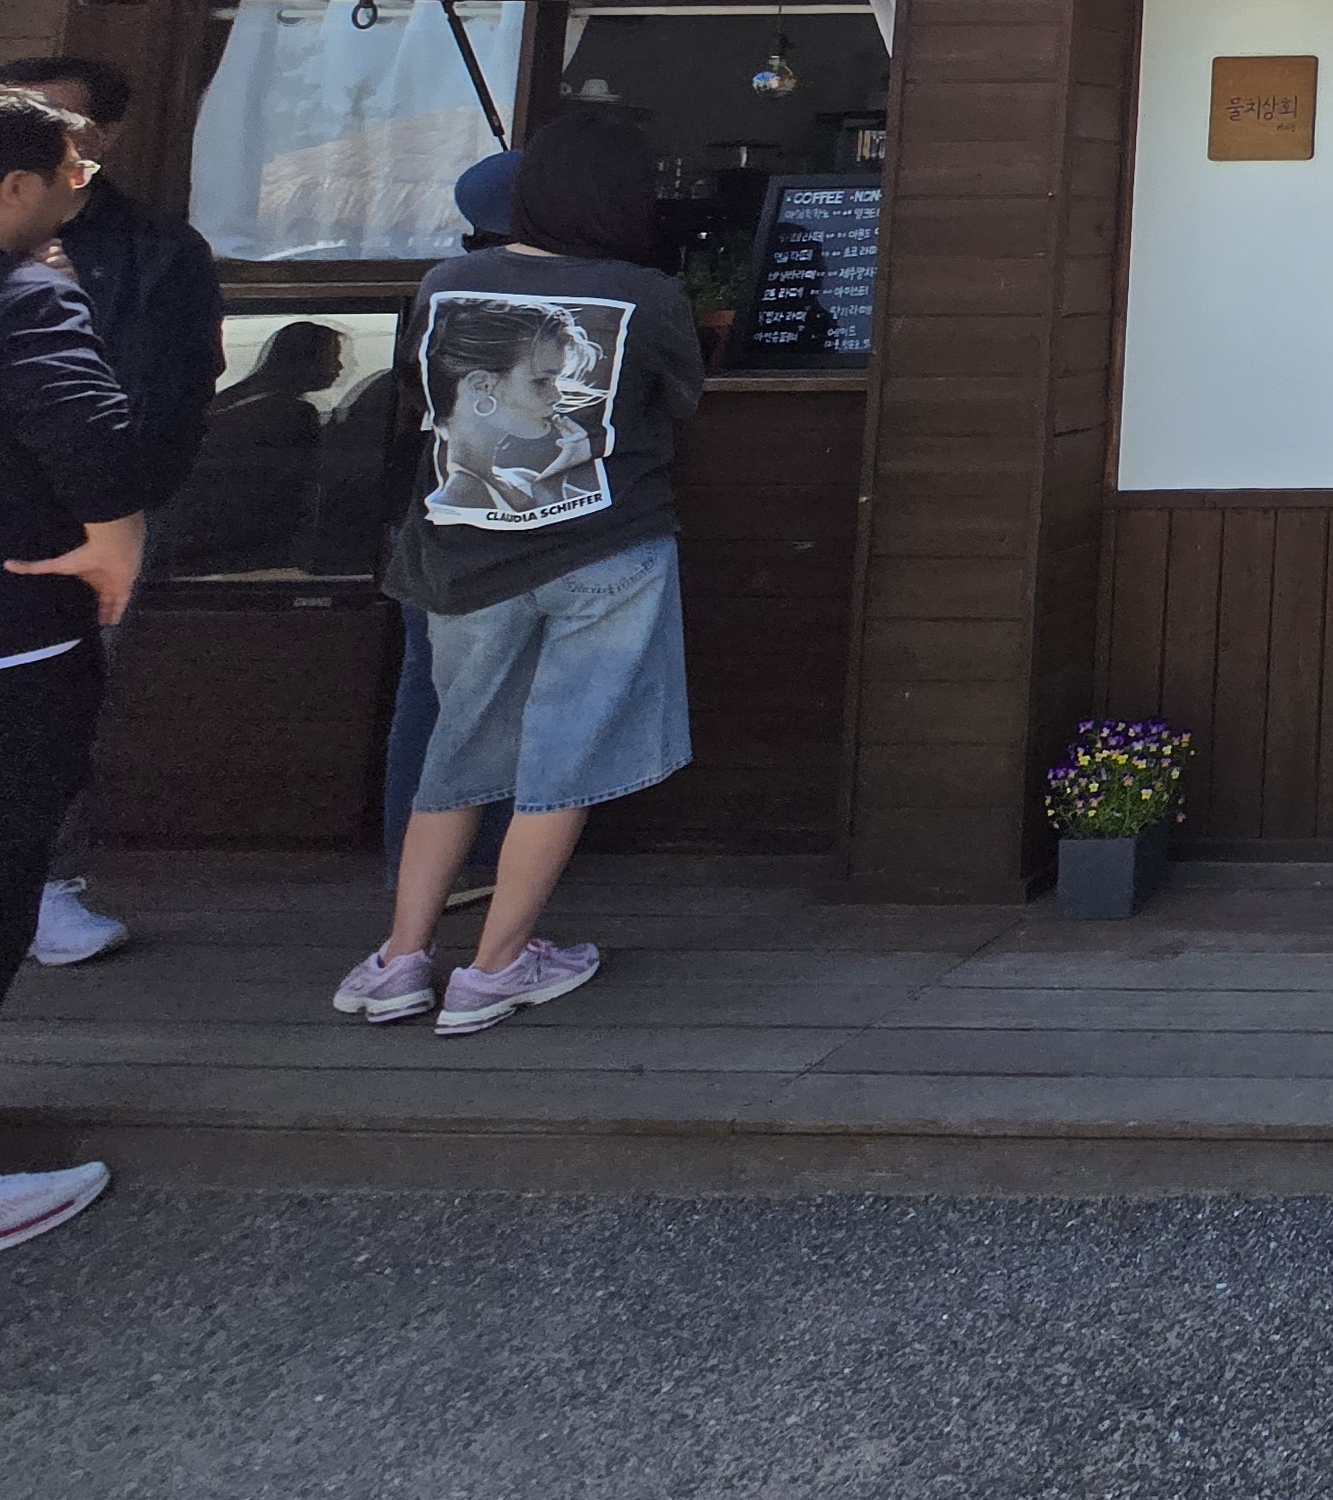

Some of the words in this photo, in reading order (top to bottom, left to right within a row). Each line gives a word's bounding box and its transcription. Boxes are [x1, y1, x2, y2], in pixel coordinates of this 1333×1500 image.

[793, 190, 845, 204] COFFEE
[486, 509, 538, 523] CLAUDIA
[540, 493, 603, 518] SCHIFFER
